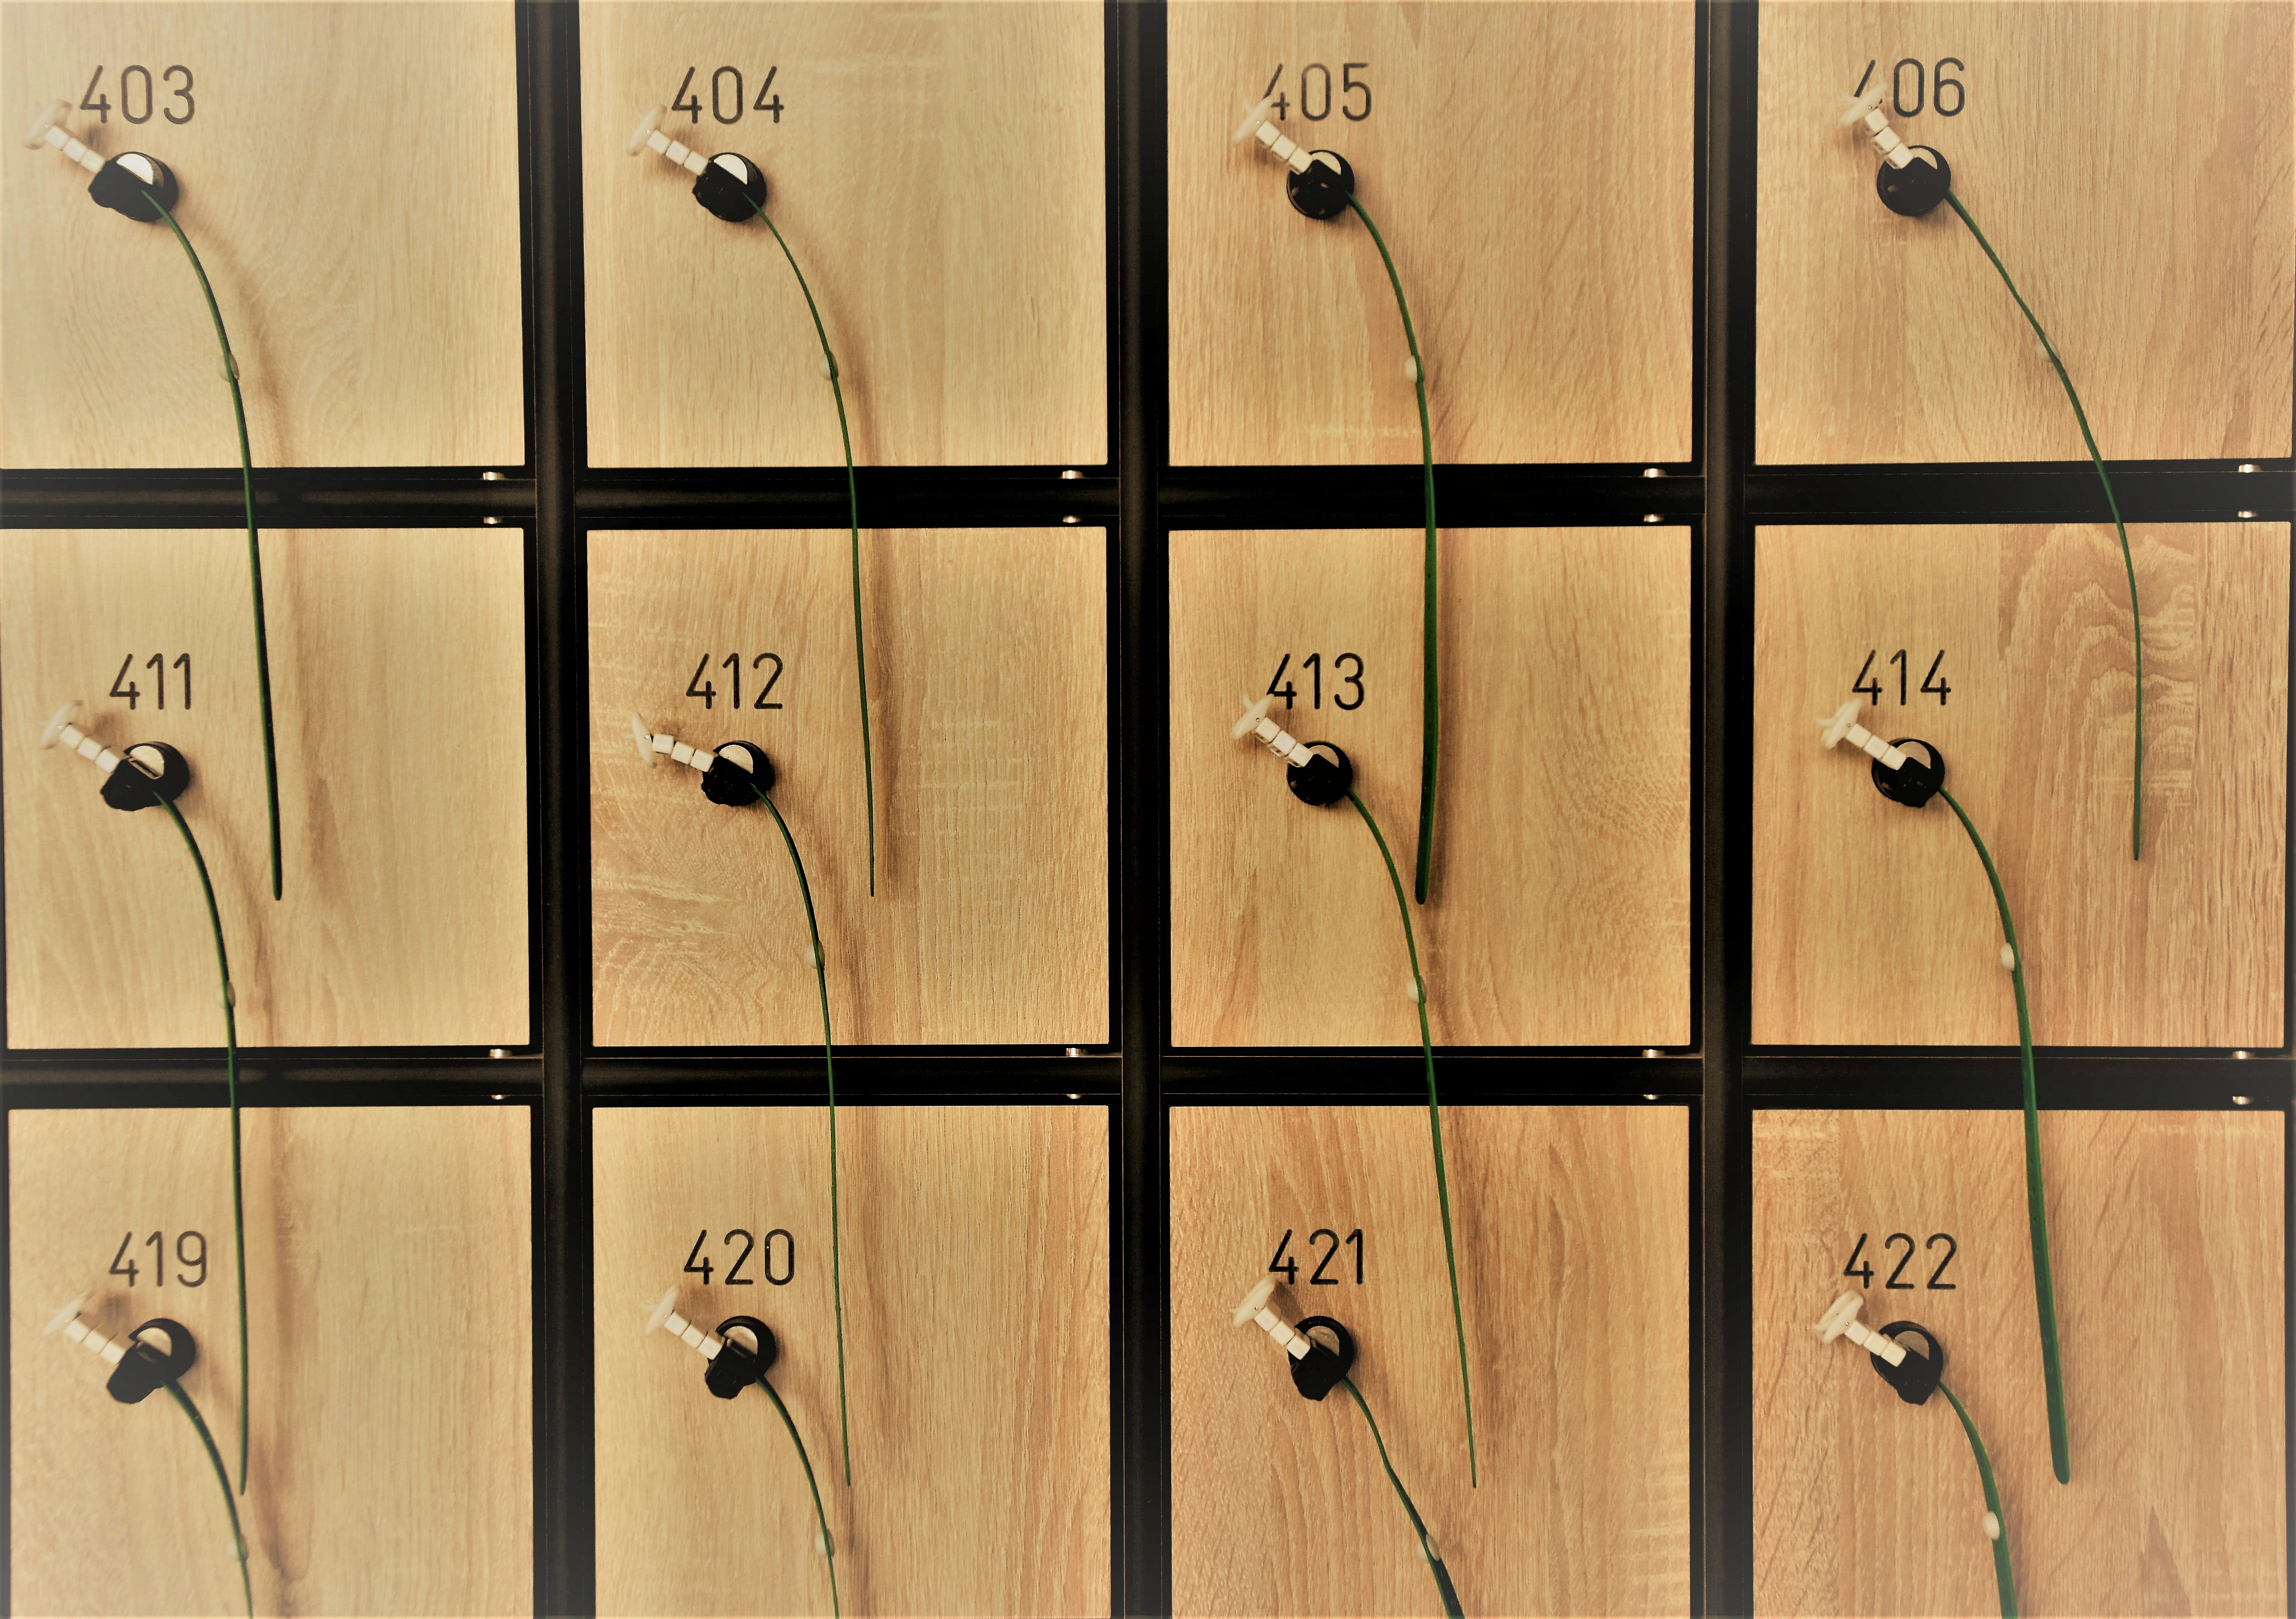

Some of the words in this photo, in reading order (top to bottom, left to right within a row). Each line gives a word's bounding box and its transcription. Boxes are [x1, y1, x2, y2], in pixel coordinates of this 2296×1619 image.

[80, 65, 195, 125] 403
[671, 66, 784, 124] 404
[1262, 63, 1372, 121] 405
[109, 653, 191, 710] 411
[686, 653, 783, 709] 412
[1266, 653, 1365, 710] 413
[1852, 649, 1951, 706] 414
[109, 1230, 207, 1288] 419
[683, 1229, 795, 1285] 420
[1268, 1229, 1364, 1285] 421
[1844, 1233, 1957, 1290] 422
